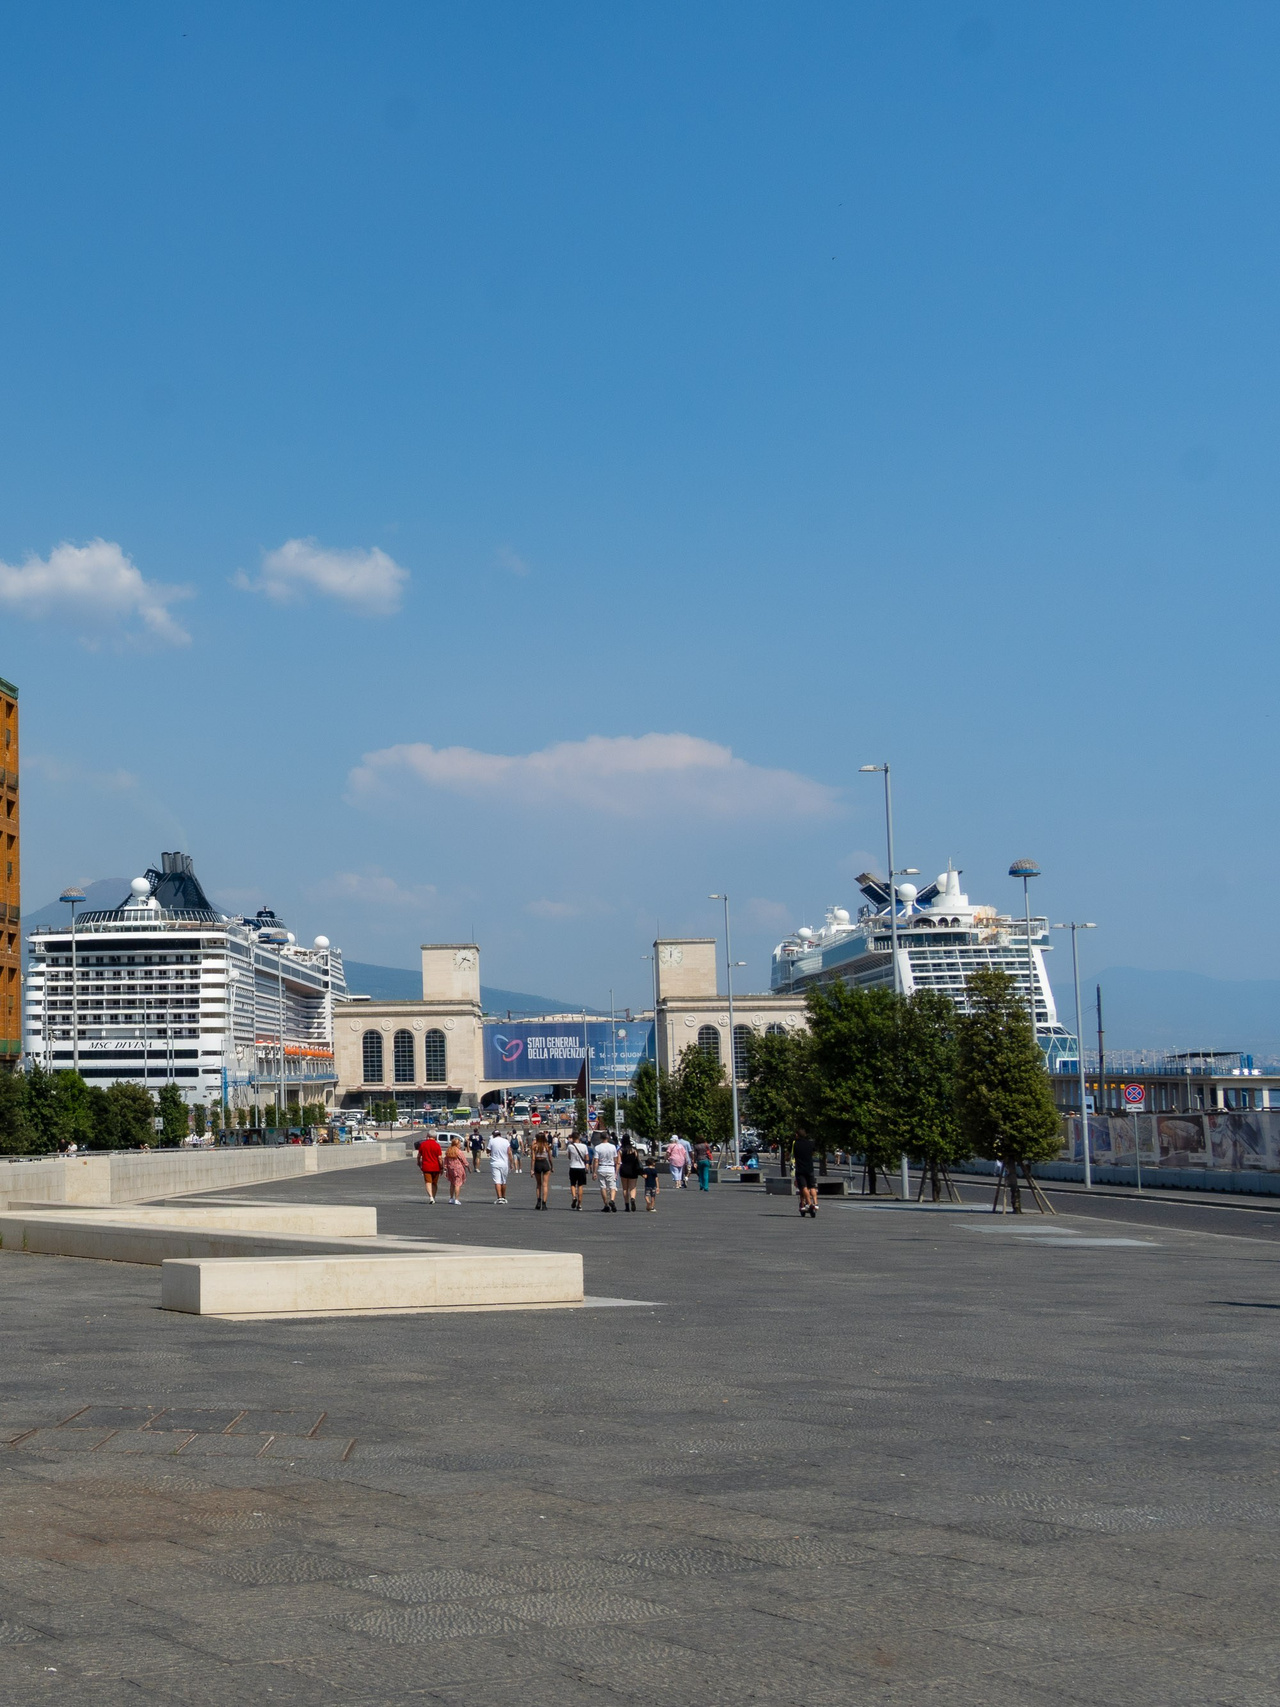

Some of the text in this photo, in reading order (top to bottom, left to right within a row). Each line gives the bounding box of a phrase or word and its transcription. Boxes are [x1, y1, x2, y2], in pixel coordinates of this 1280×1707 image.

[89, 1041, 153, 1049] MSC DIVINA
[527, 1036, 579, 1048] STATI GENERALI
[528, 1047, 596, 1059] DELLA PREVENZIOE
